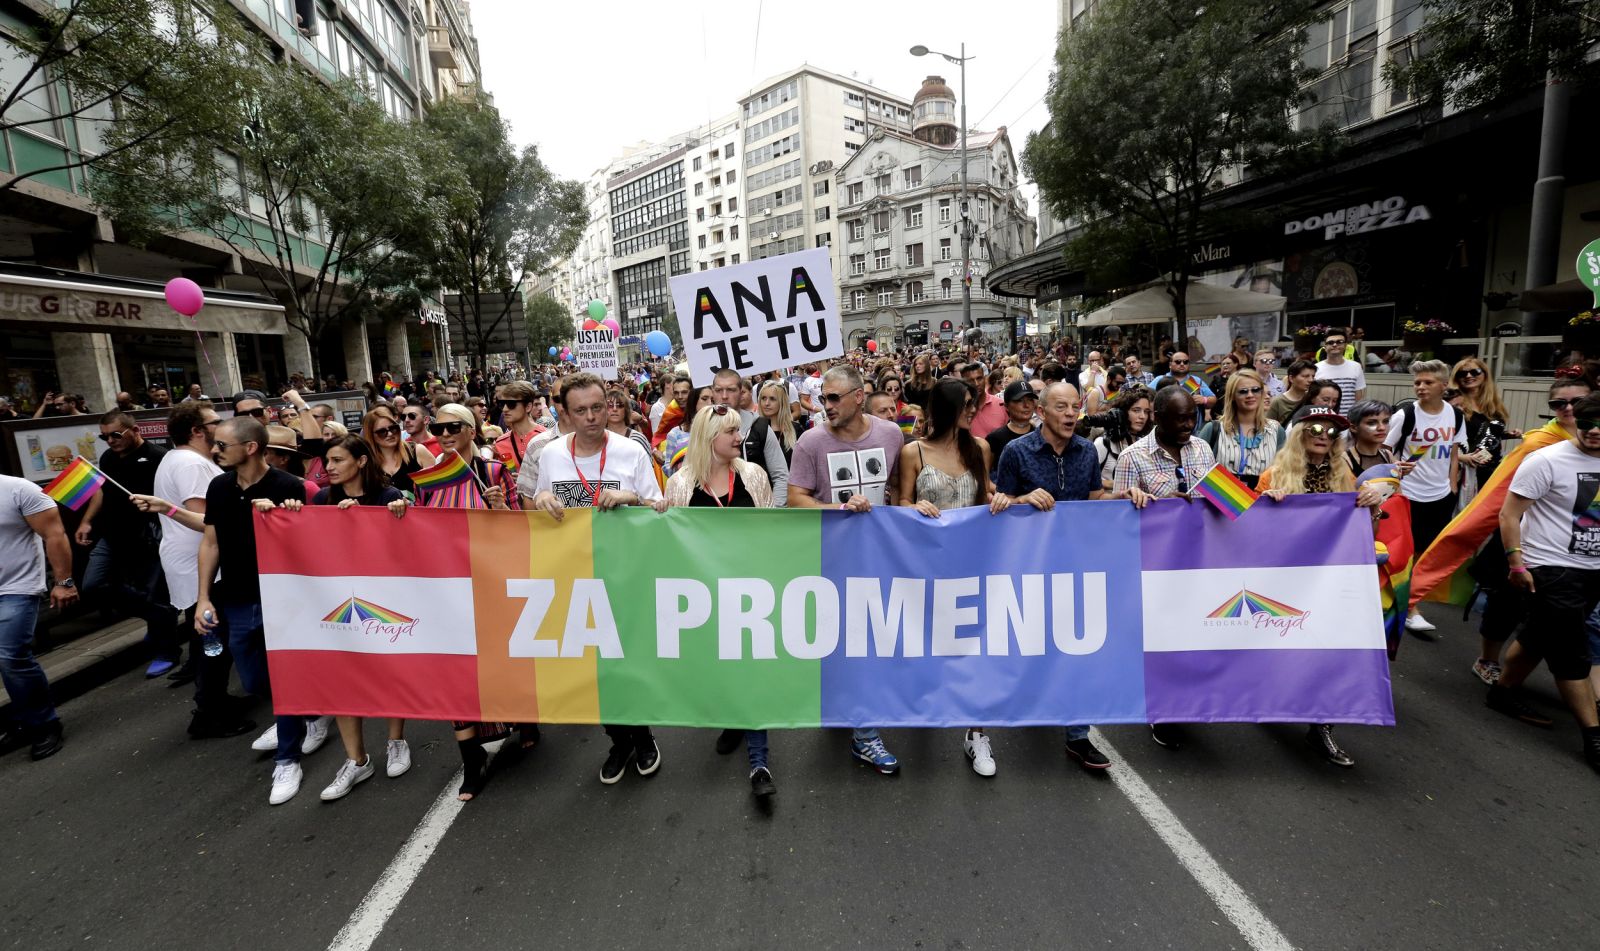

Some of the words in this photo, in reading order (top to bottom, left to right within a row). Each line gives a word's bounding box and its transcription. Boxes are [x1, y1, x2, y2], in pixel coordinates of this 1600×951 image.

[1284, 195, 1407, 236] DOMINO
[1325, 204, 1432, 240] PIZZA
[1190, 243, 1231, 265] xMara
[949, 267, 984, 276] EVOPA
[693, 266, 825, 340] ANA
[577, 330, 613, 343] USTAV
[701, 334, 754, 374] JE
[767, 318, 828, 360] TU
[580, 351, 615, 359] PREMIJERKI
[591, 360, 599, 368] SE
[506, 577, 624, 660] ZA
[655, 572, 1108, 660] PROMENU
[1203, 620, 1249, 628] BEOGRAD
[1252, 610, 1311, 637] Prajd
[319, 622, 359, 632] BEOGRAD
[362, 617, 419, 643] Prajd
